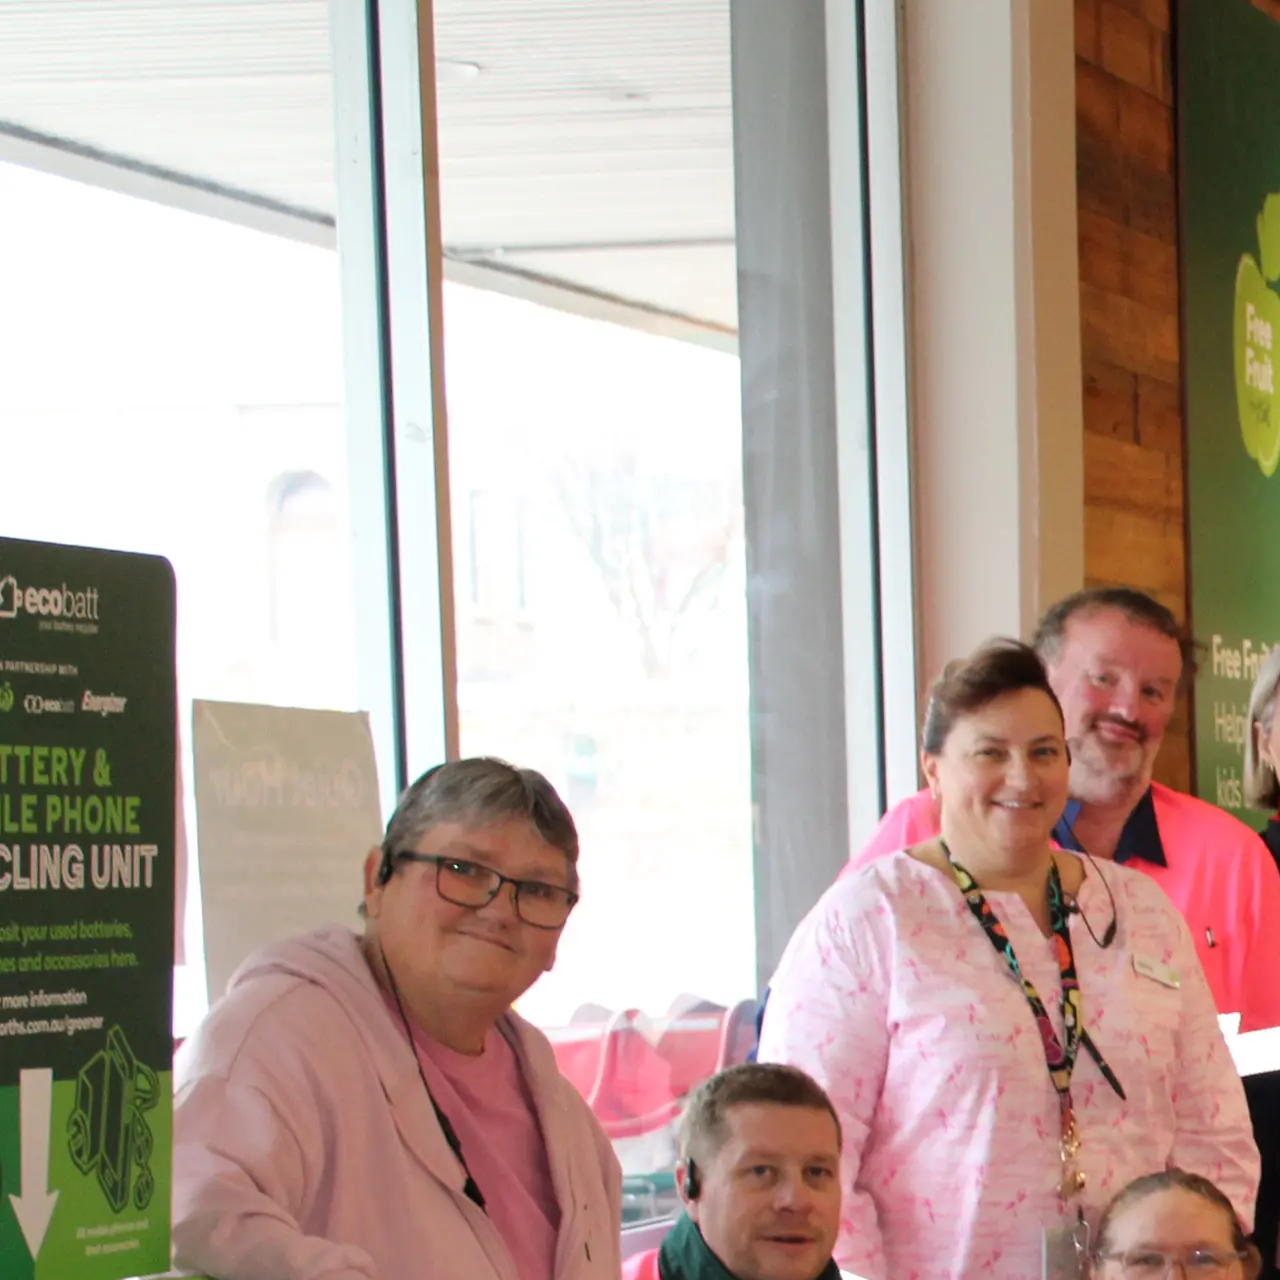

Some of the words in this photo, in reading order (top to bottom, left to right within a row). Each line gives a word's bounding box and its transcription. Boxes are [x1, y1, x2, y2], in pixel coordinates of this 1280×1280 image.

[1245, 302, 1272, 350] Free
[1245, 347, 1274, 395] Fruit
[25, 582, 99, 620] ecobatt
[1212, 633, 1242, 680] Free
[93, 747, 112, 788] &
[46, 794, 142, 835] PHONE
[91, 843, 158, 890] UNIT
[21, 925, 48, 948] your
[50, 920, 79, 940] used
[18, 951, 42, 973] and
[44, 949, 110, 971] accessories
[3, 995, 29, 1010] more
[30, 988, 88, 1008] information
